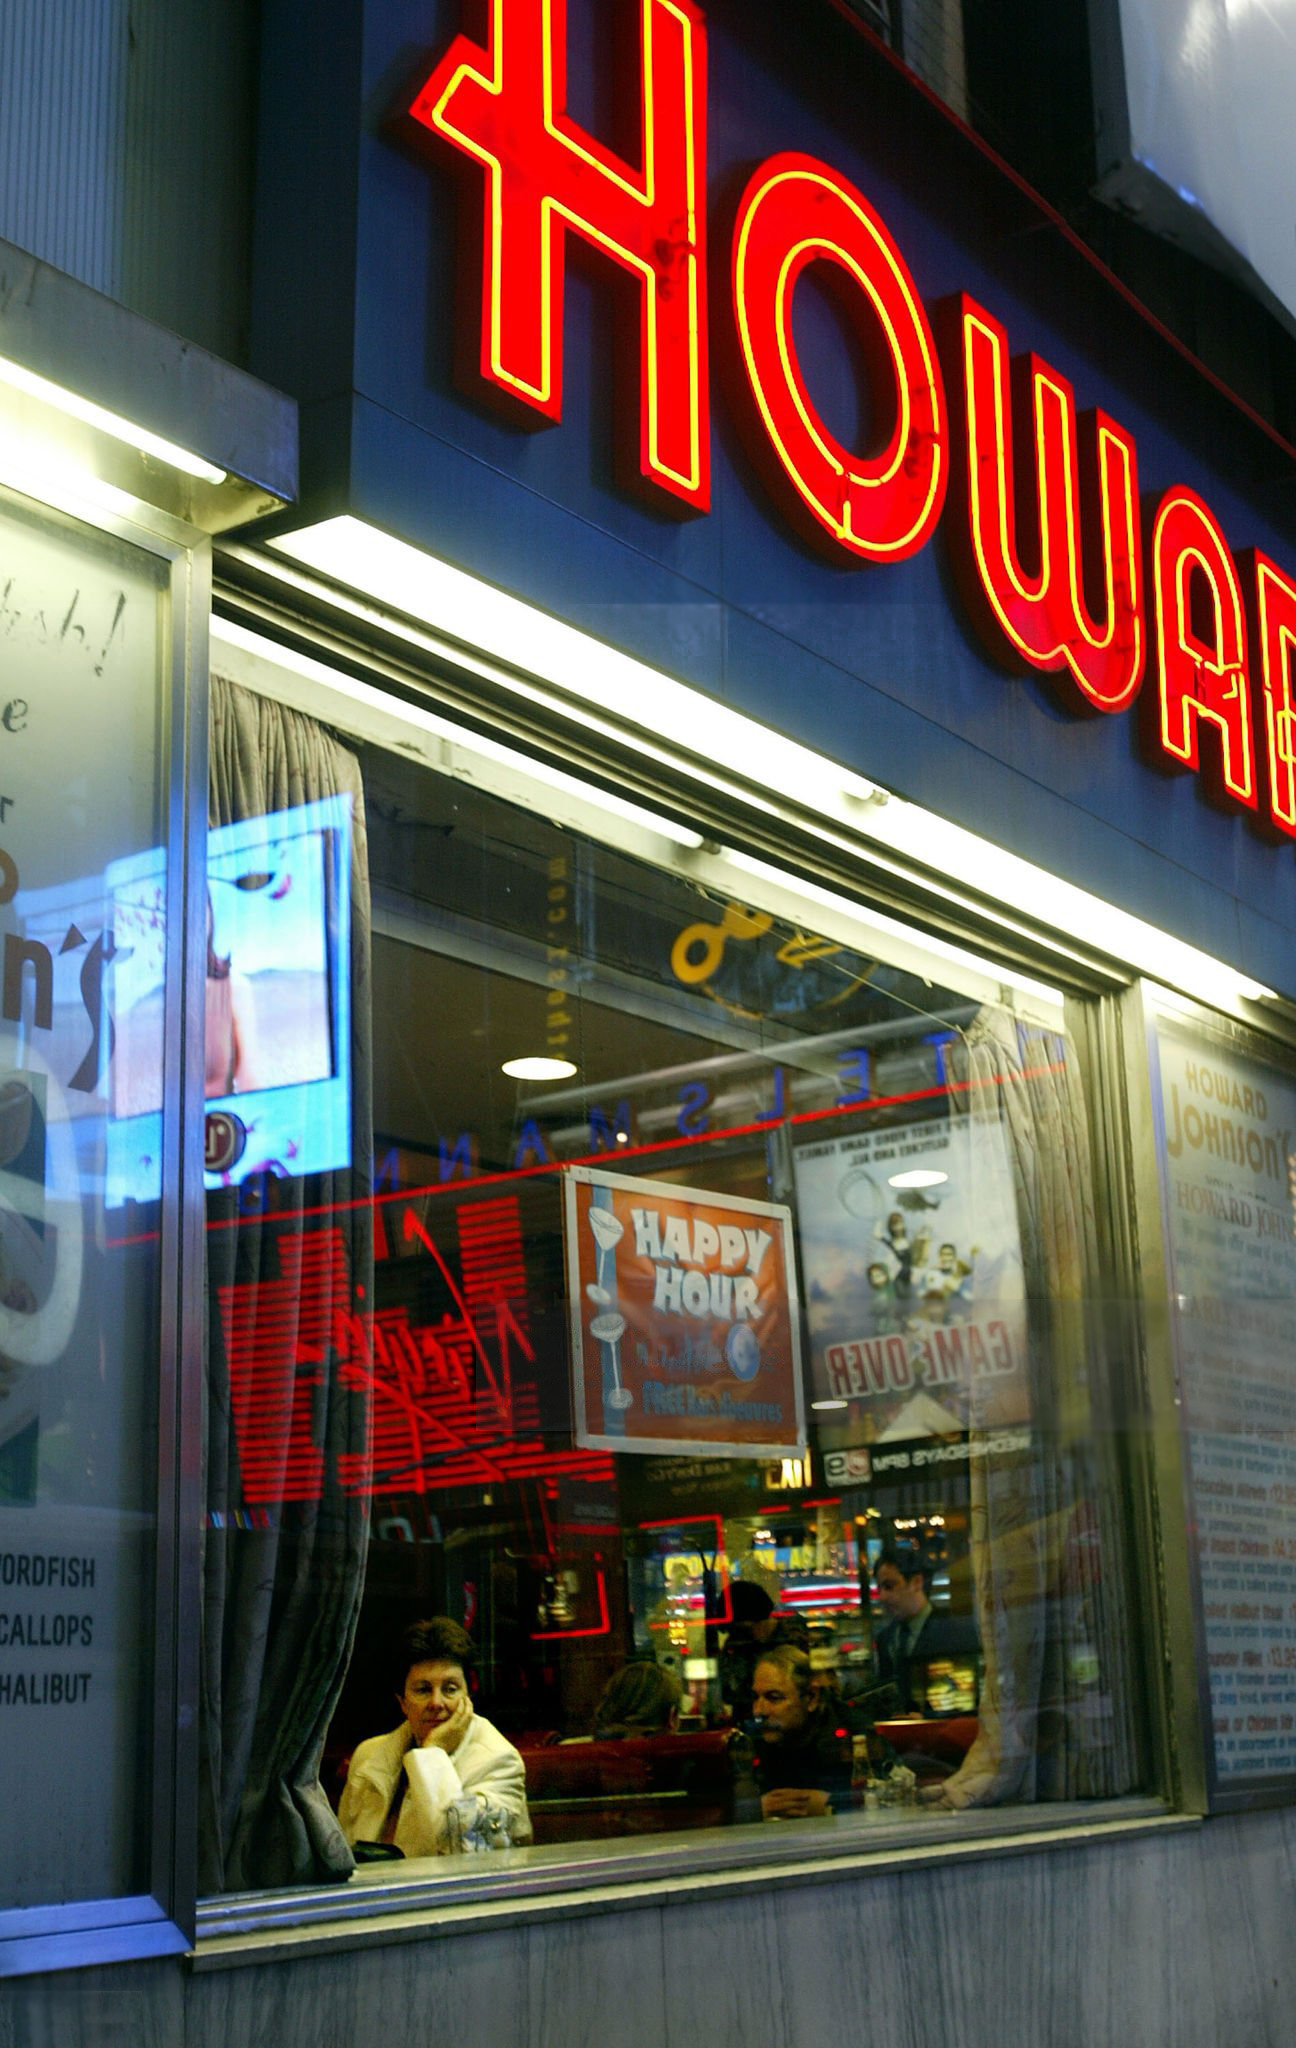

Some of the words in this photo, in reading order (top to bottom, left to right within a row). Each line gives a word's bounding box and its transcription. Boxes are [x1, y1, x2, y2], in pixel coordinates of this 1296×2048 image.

[1186, 1060, 1268, 1121] HOWARD
[1176, 1180, 1253, 1229] HOWARD
[630, 1208, 773, 1276] HAPPY
[653, 1264, 764, 1320] HOUR
[0, 1552, 95, 1587] ORDFISH
[0, 1673, 92, 1705] HALIBUT
